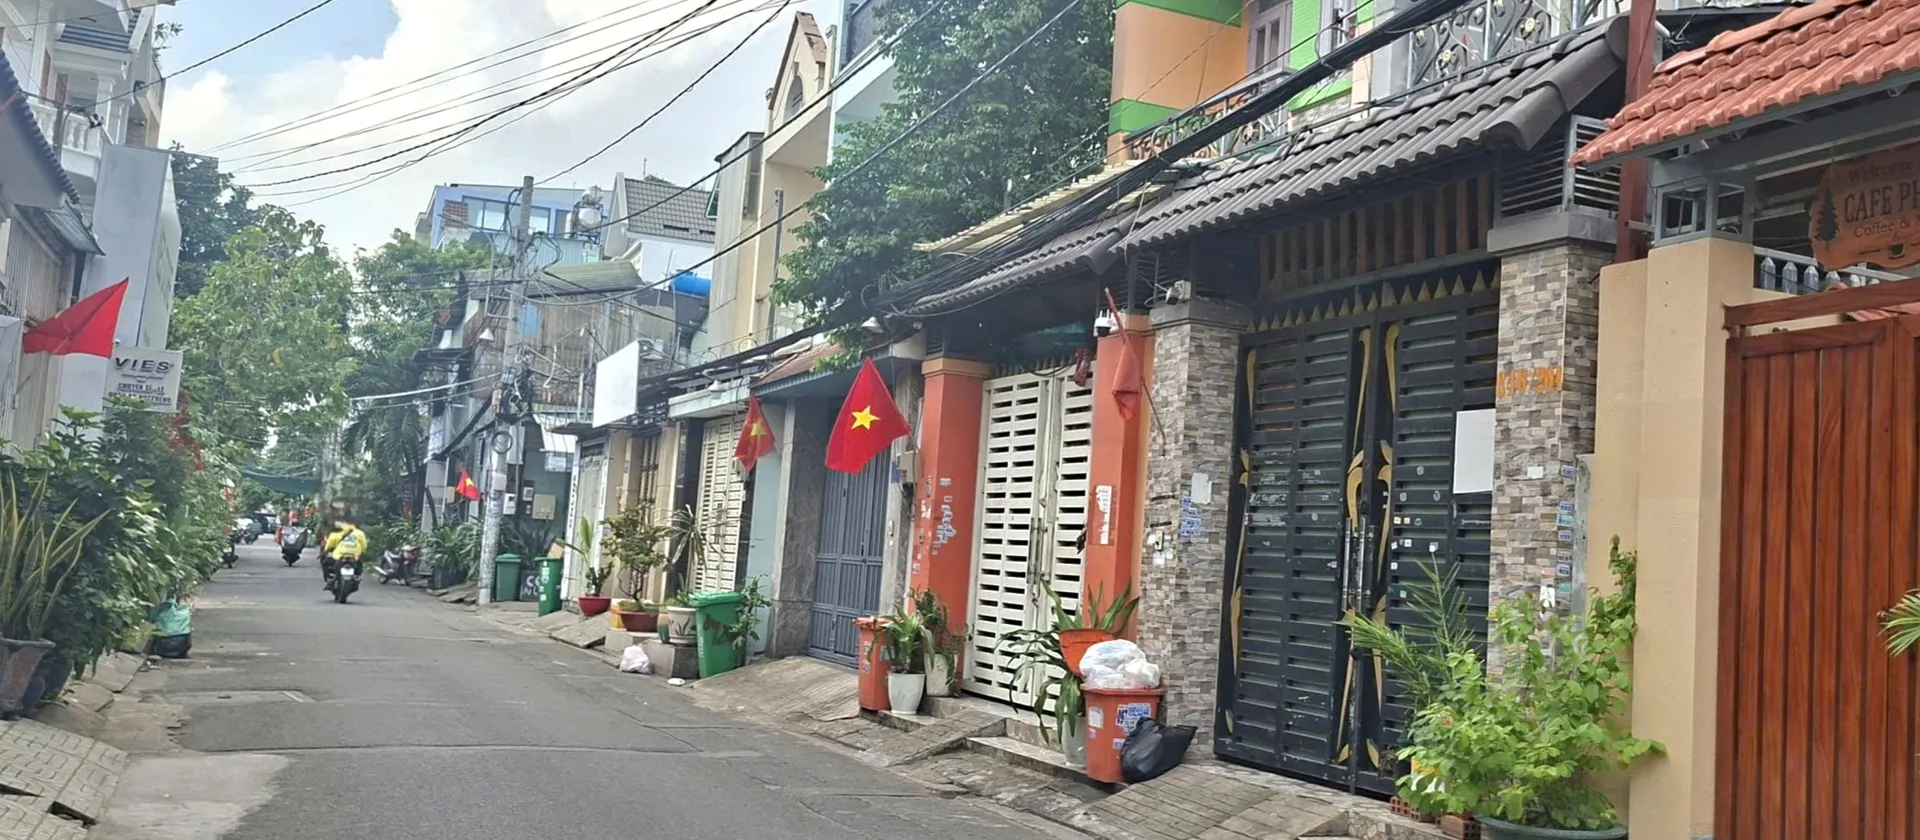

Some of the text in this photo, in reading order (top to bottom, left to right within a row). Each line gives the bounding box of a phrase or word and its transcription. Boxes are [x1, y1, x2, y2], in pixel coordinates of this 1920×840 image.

[1849, 162, 1913, 183] Welcome
[1845, 185, 1893, 223] CAFE
[1854, 220, 1895, 237] Coffee
[1900, 215, 1912, 228] &
